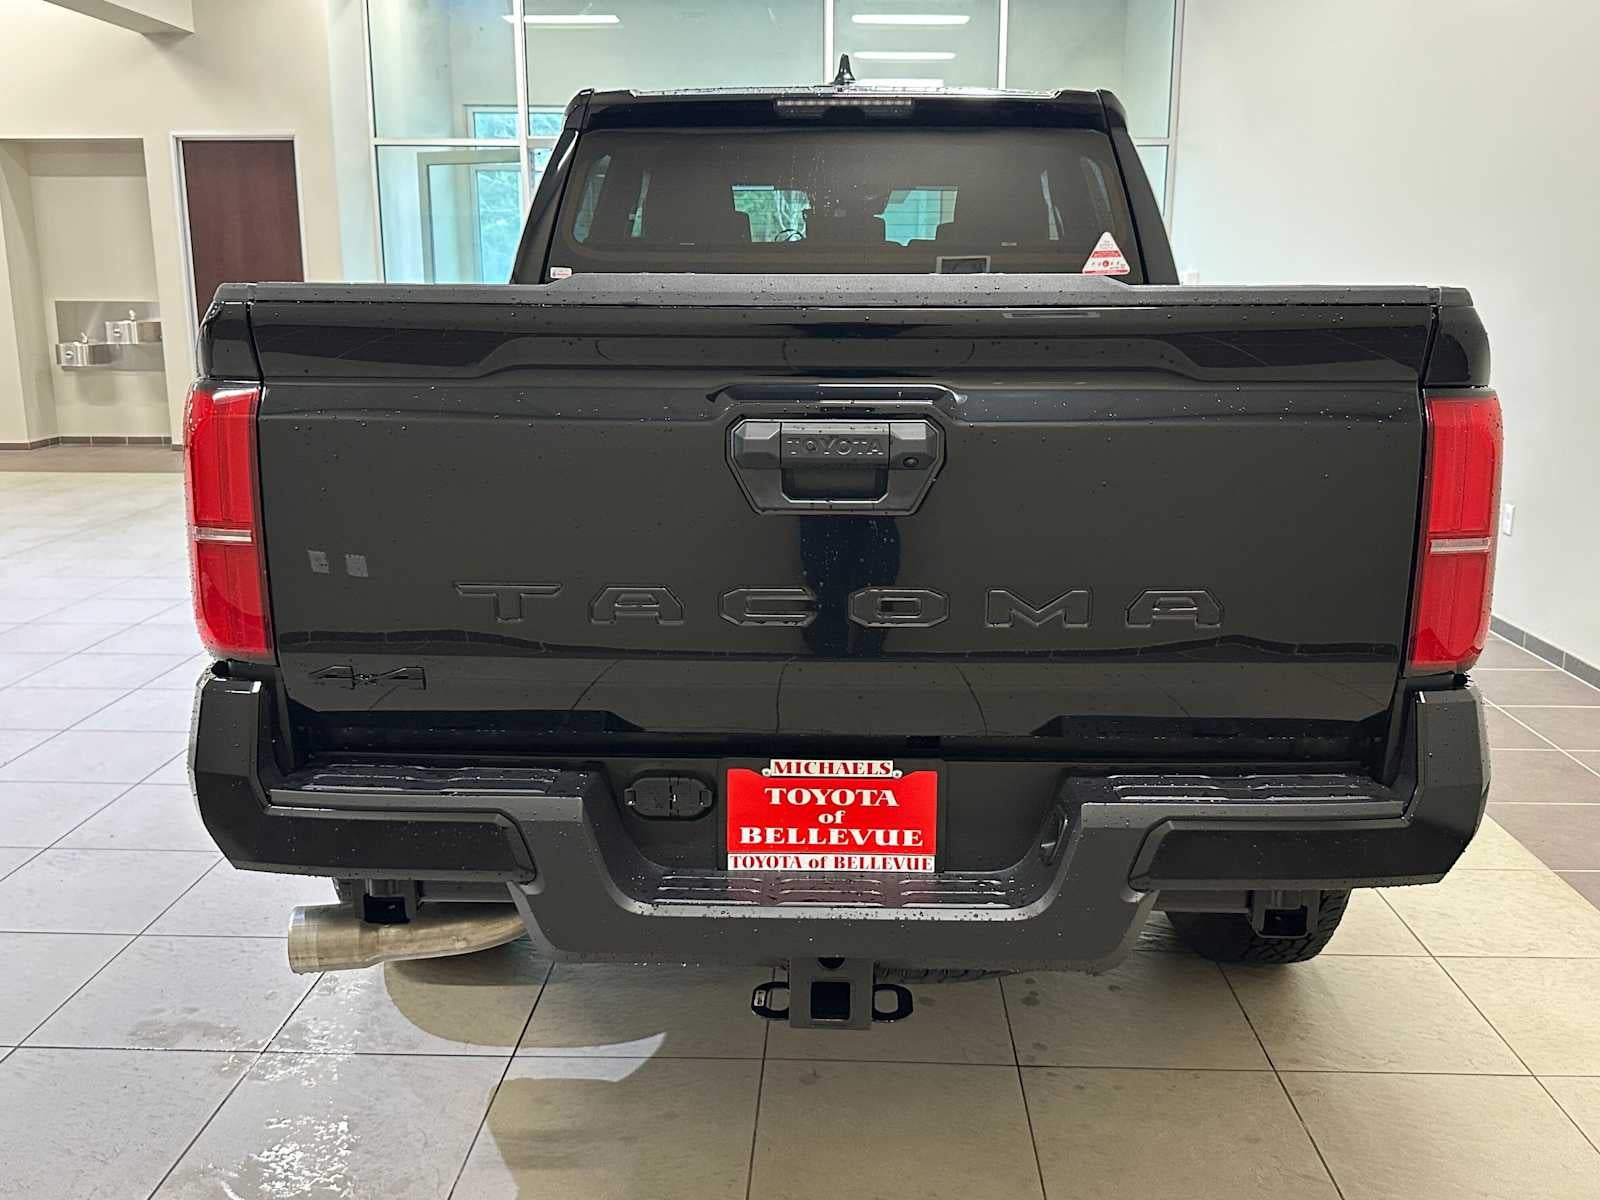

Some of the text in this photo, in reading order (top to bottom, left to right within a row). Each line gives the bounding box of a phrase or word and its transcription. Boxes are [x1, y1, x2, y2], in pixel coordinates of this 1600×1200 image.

[786, 436, 884, 456] TOYOTA
[454, 582, 1223, 628] TACOMA
[773, 761, 891, 776] MICHAELS
[765, 787, 899, 807] TOYOTA
[818, 809, 846, 824] of
[740, 826, 923, 847] BELLEVUE
[730, 855, 933, 871] TOYOTA of BELLEVUE
